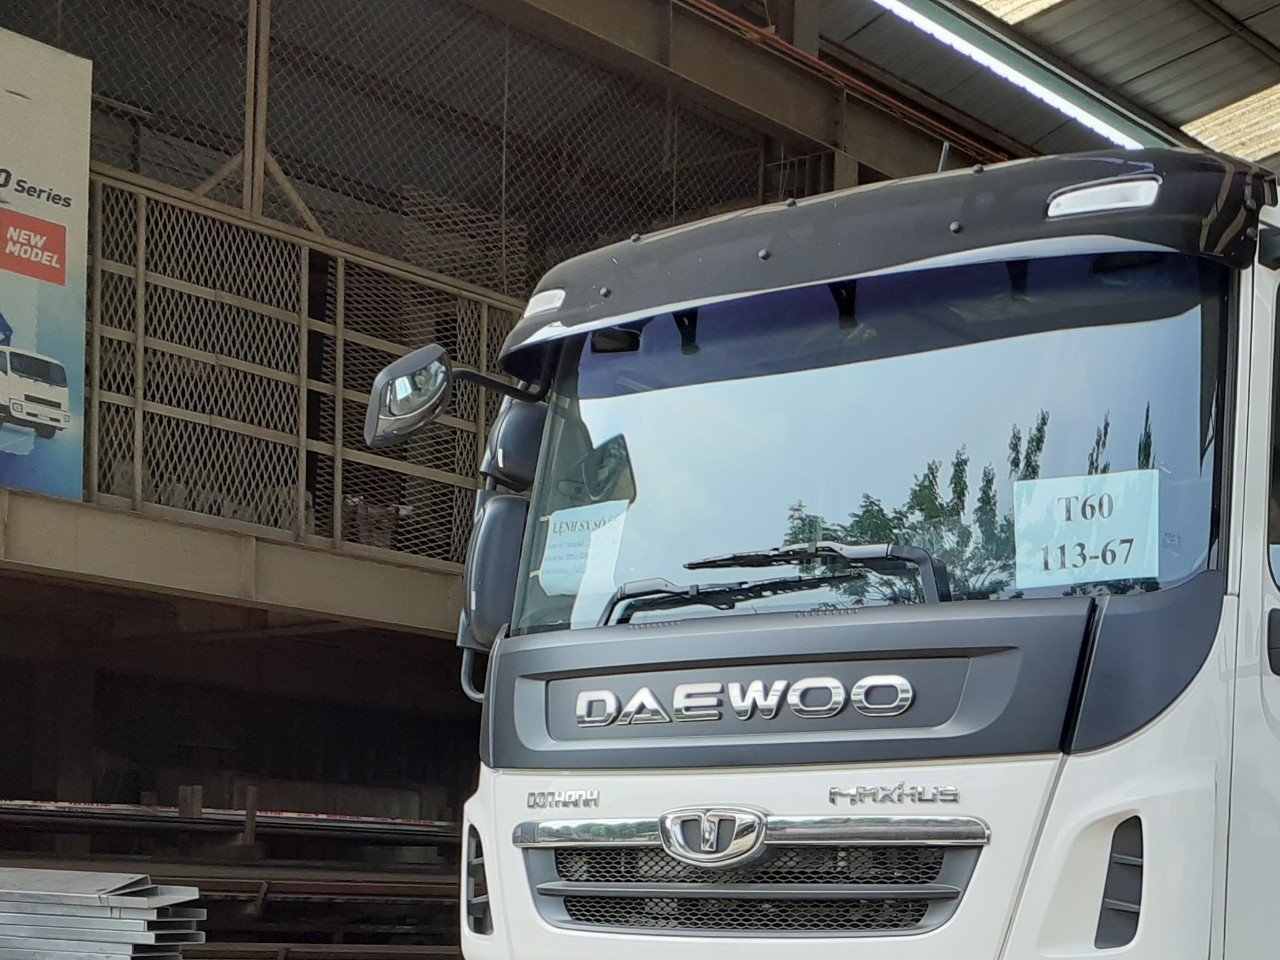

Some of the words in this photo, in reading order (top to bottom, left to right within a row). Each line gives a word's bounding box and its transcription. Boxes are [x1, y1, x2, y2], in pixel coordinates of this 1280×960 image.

[14, 179, 72, 208] Series
[6, 226, 48, 249] NEW
[5, 241, 61, 268] MODEL
[1058, 493, 1114, 522] T60
[1040, 538, 1134, 572] 113-67
[575, 675, 915, 728] DAEWOO
